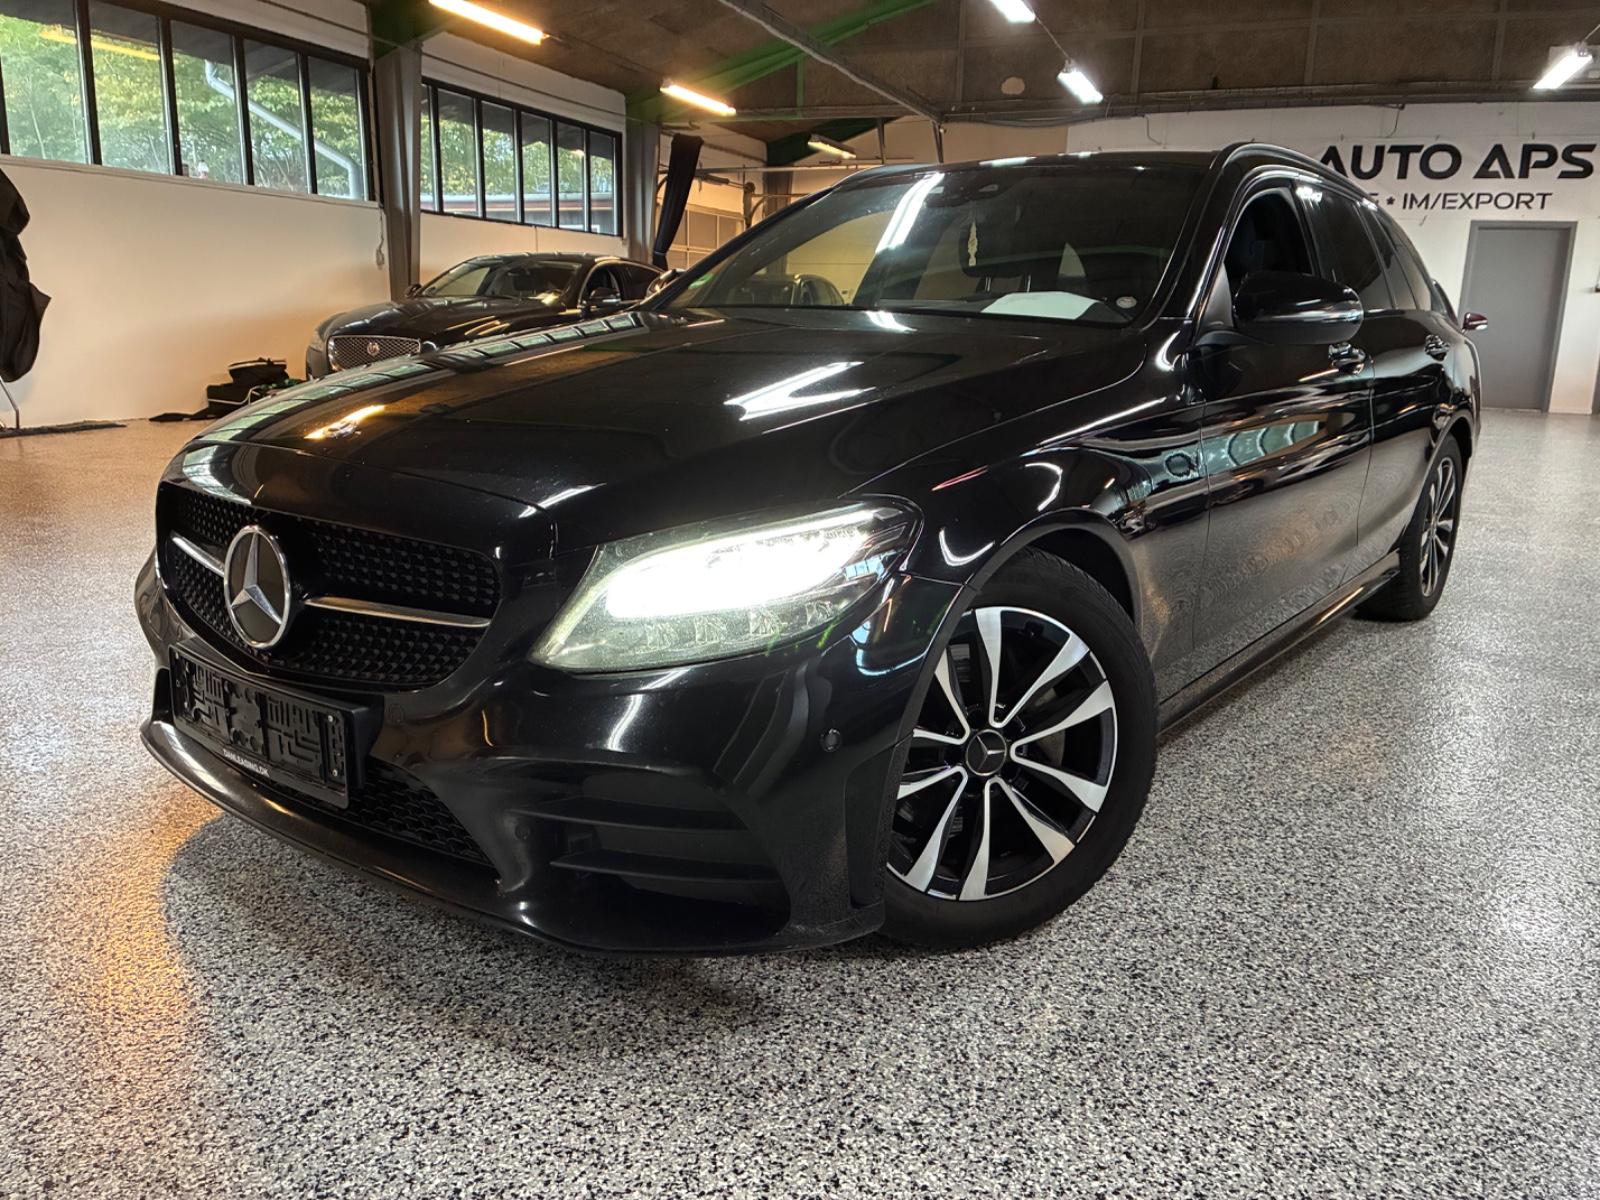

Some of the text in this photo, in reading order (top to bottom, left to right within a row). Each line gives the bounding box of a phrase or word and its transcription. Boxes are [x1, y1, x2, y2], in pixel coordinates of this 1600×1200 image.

[1320, 143, 1597, 180] AUTO APS
[1402, 192, 1553, 210] IM/EXPORT
